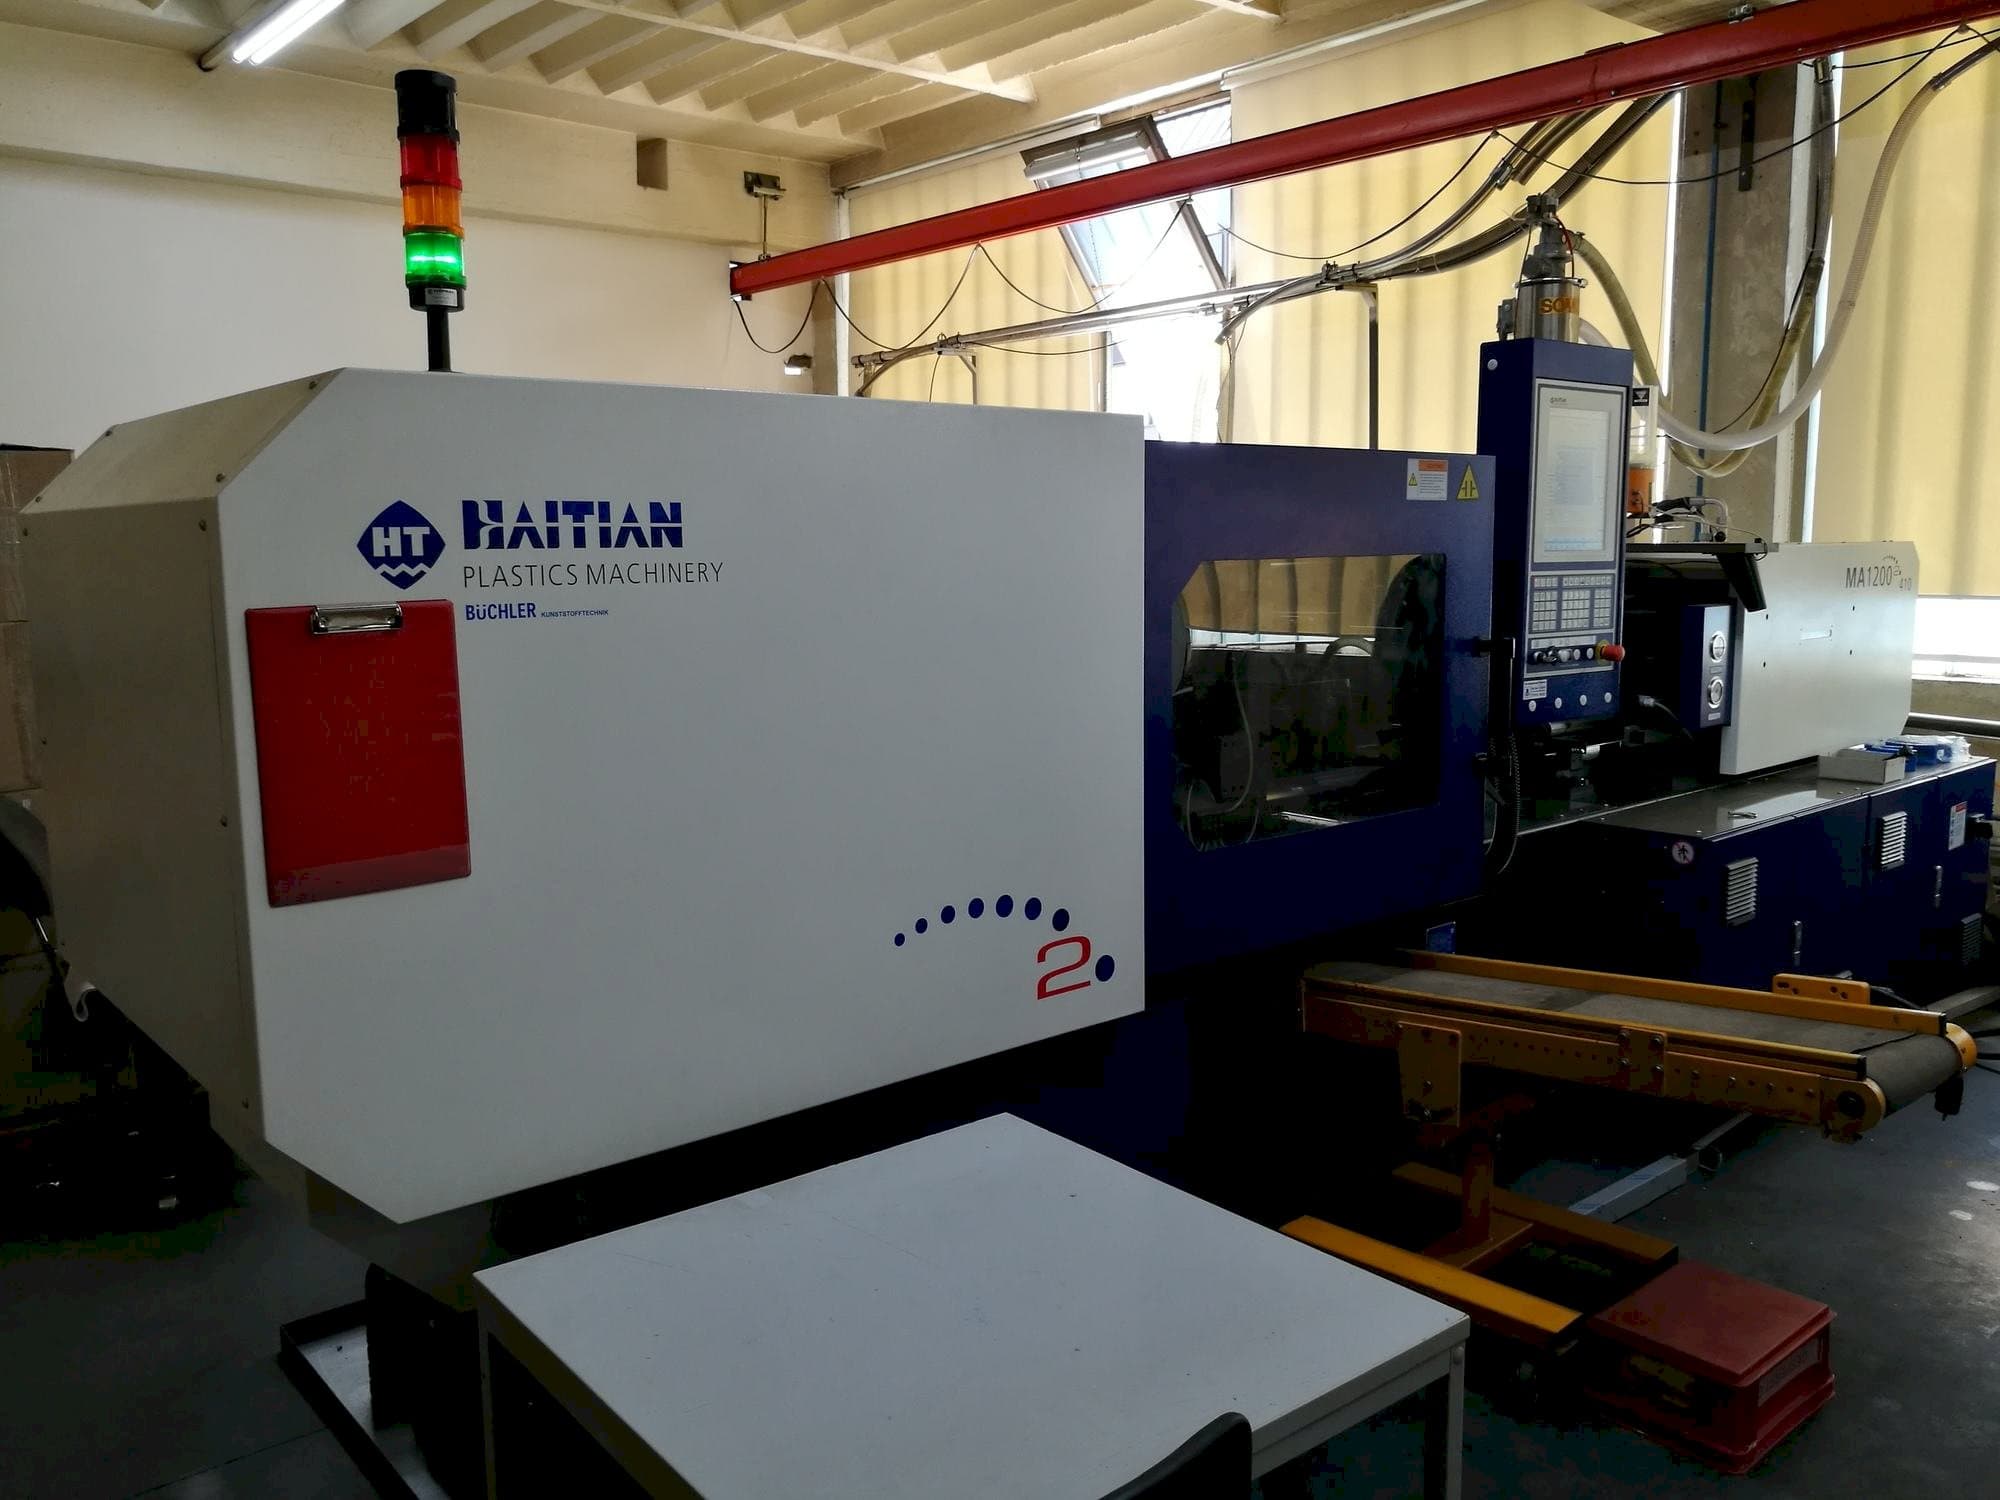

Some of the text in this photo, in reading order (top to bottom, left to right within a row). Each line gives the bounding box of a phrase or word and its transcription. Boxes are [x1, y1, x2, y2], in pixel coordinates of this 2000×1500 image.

[462, 500, 683, 550] HAITIAN
[372, 526, 430, 557] HT
[464, 562, 723, 588] PLASTICS MACHINERY
[1845, 566, 1893, 588] MA1200
[541, 609, 609, 617] KUNSTSTOFFTECHNIK
[1037, 936, 1091, 1000] 2
